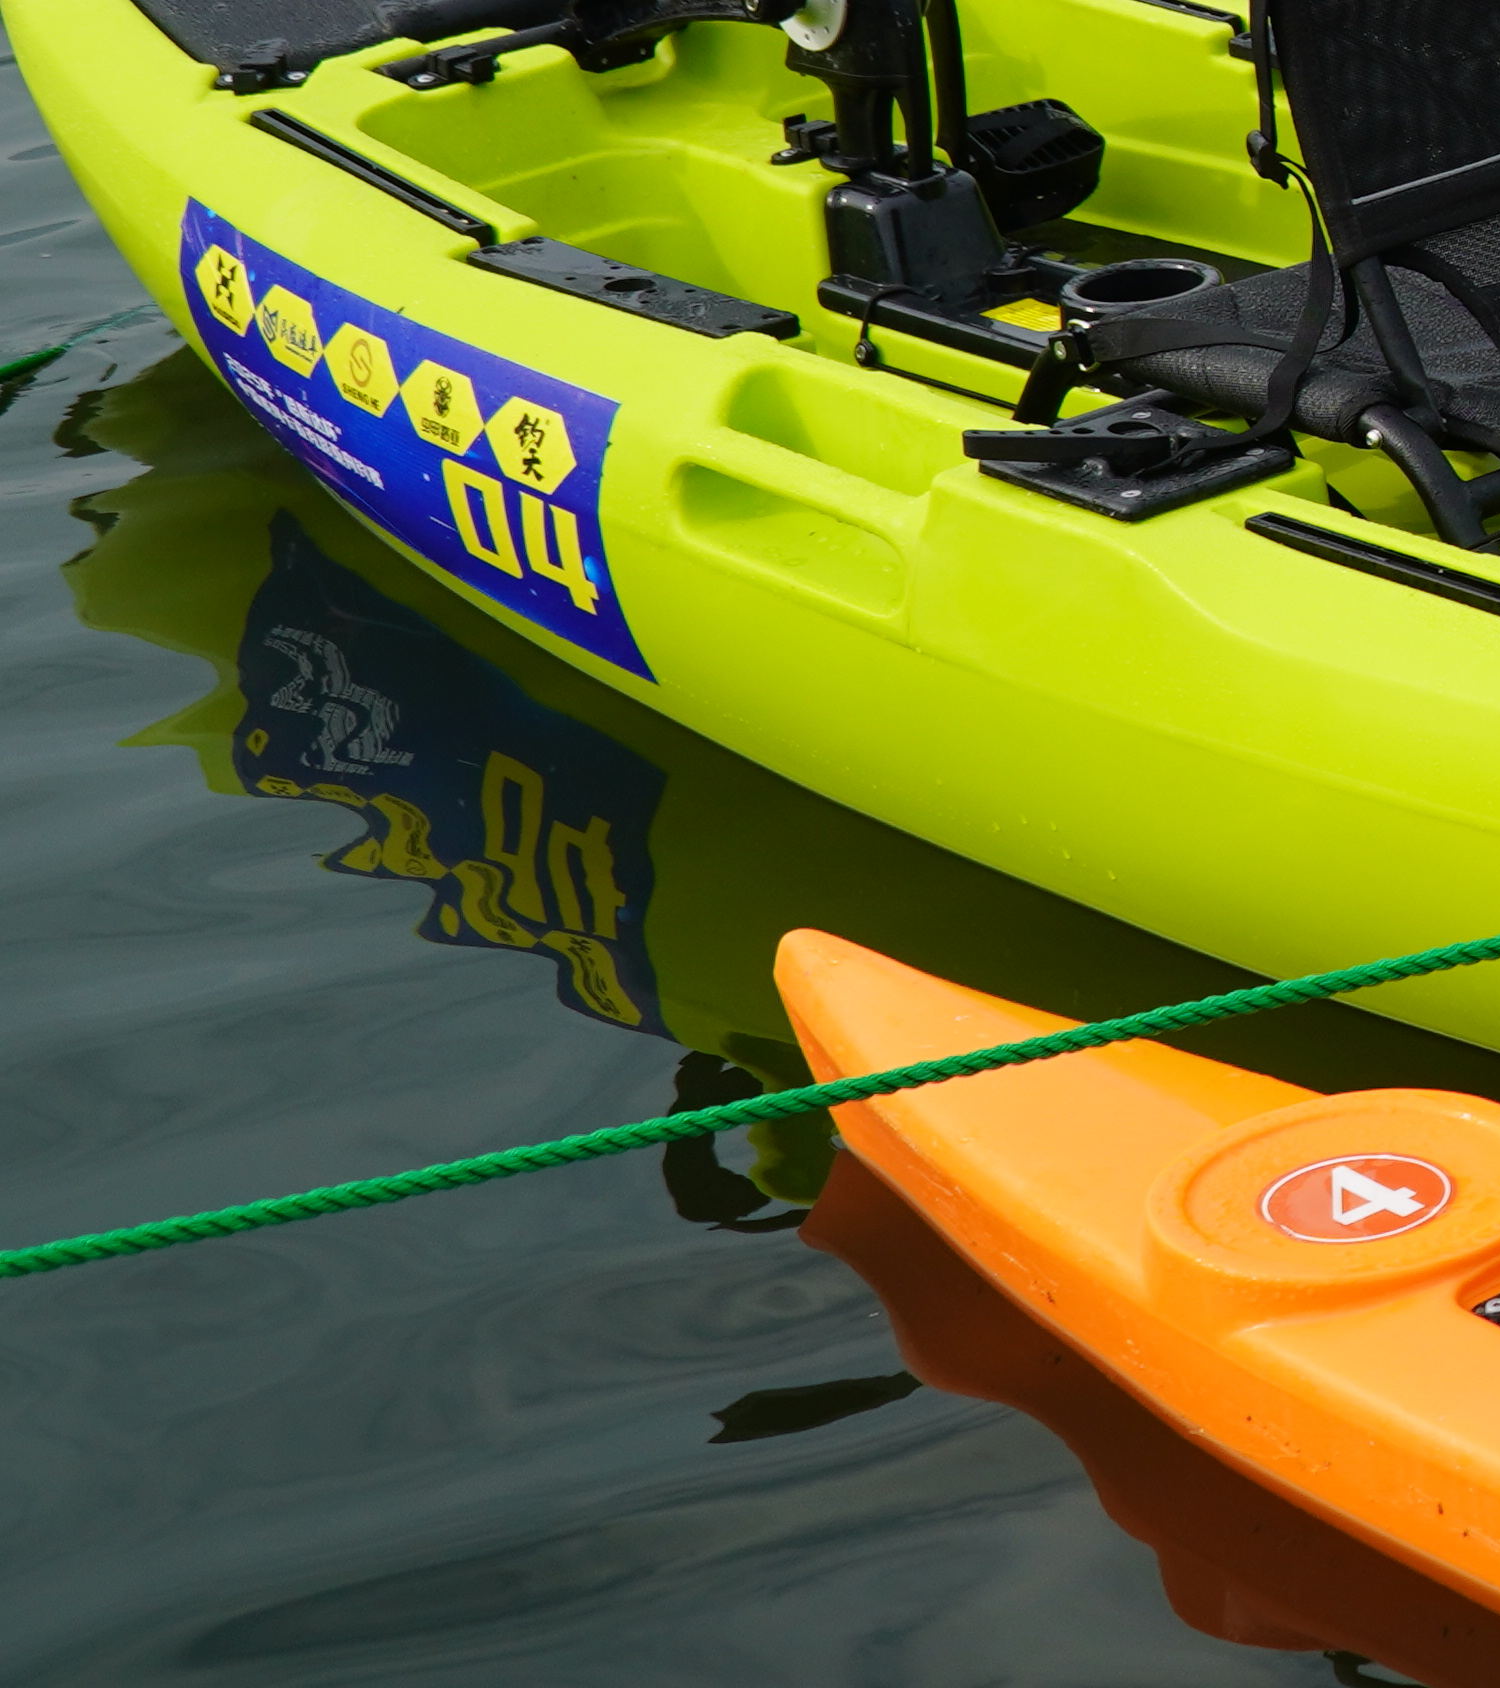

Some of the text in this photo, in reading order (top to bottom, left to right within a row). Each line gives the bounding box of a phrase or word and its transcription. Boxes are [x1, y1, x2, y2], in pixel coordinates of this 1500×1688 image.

[513, 412, 546, 482] 钓天
[441, 457, 600, 616] 04
[1331, 1165, 1426, 1227] 4
